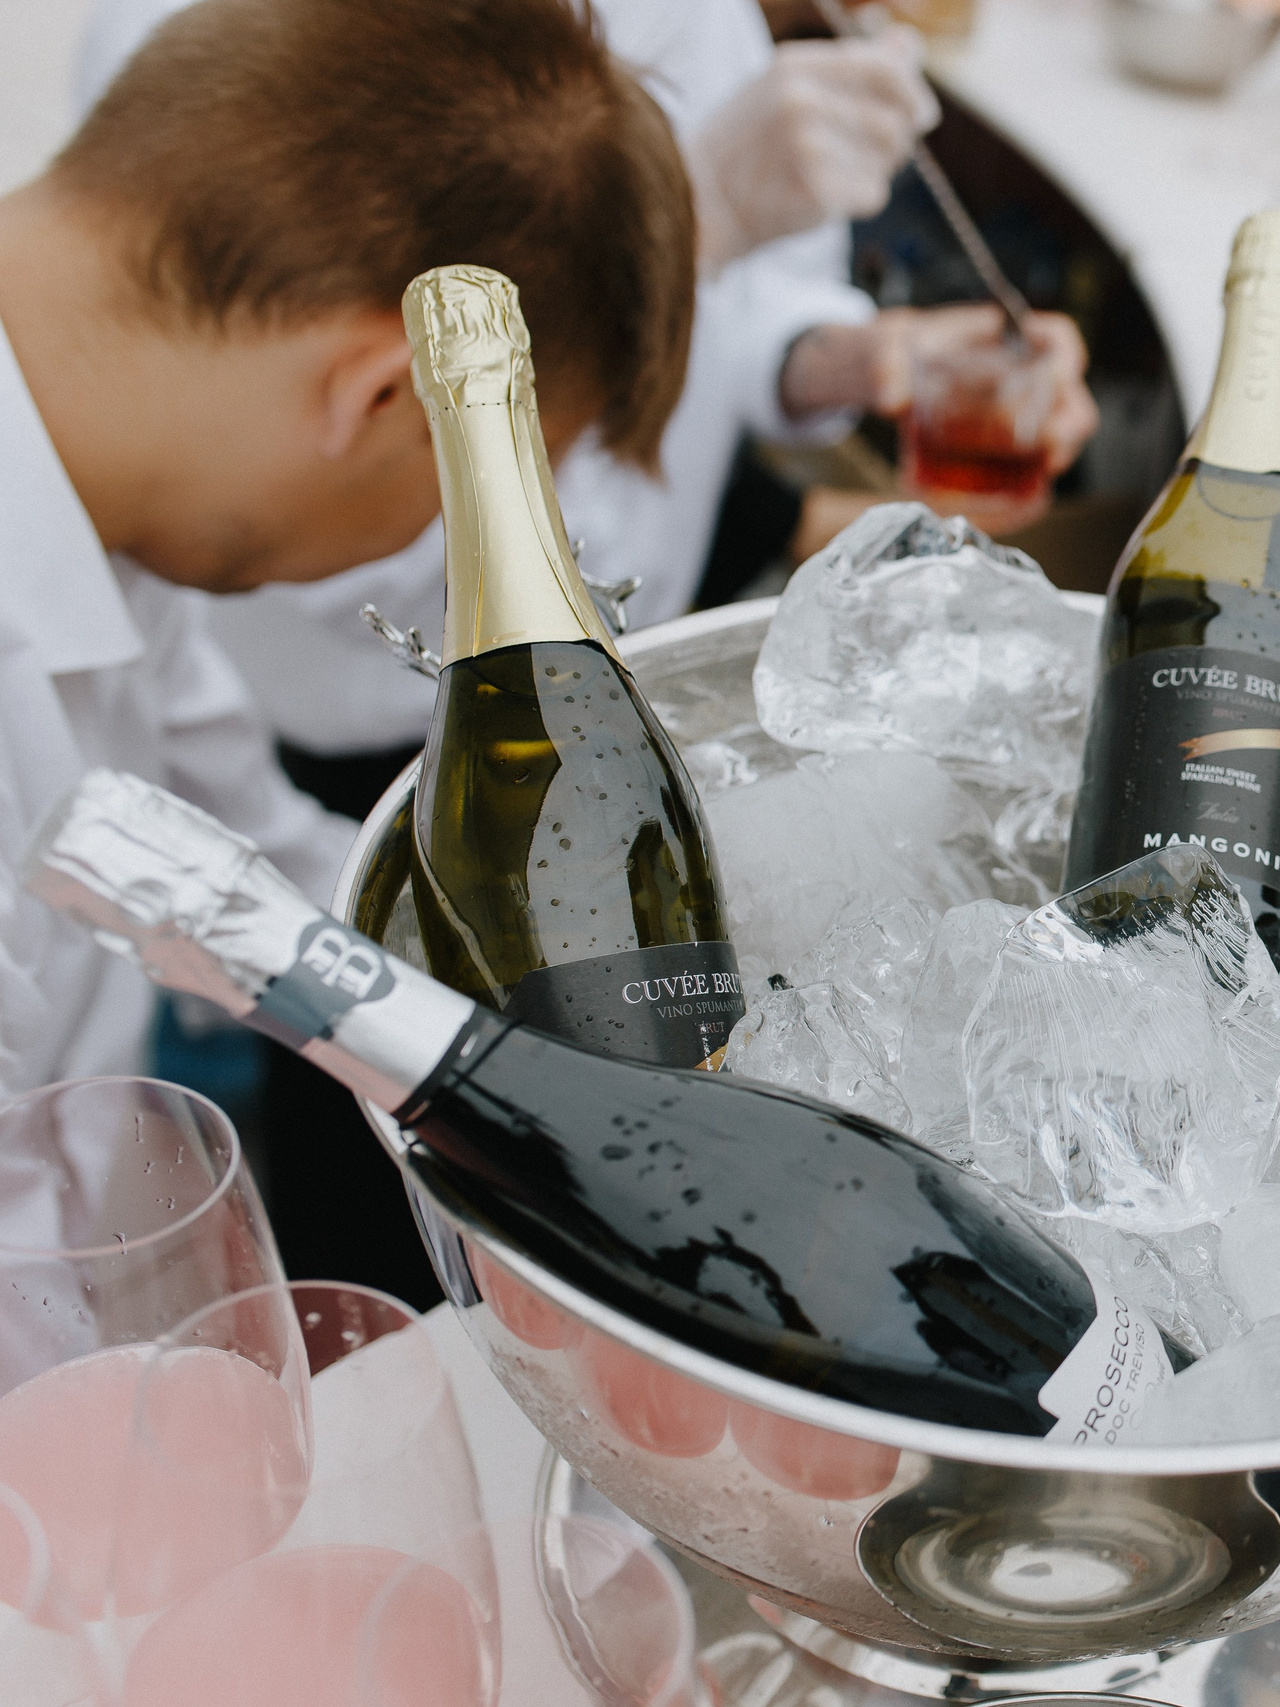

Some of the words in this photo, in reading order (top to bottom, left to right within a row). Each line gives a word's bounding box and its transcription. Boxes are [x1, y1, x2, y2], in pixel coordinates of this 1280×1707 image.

[1152, 665, 1238, 690] CUVÉE
[1180, 771, 1234, 786] SPARKLING
[1235, 779, 1261, 793] WINE
[1186, 763, 1225, 775] ITALIAN
[1226, 767, 1257, 782] SWEET
[1143, 833, 1280, 870] MANGONI
[622, 970, 709, 1004] CUVÉE
[657, 1003, 693, 1018] VINO
[1105, 1399, 1130, 1445] DOC
[1126, 1323, 1145, 1392] TREVISO
